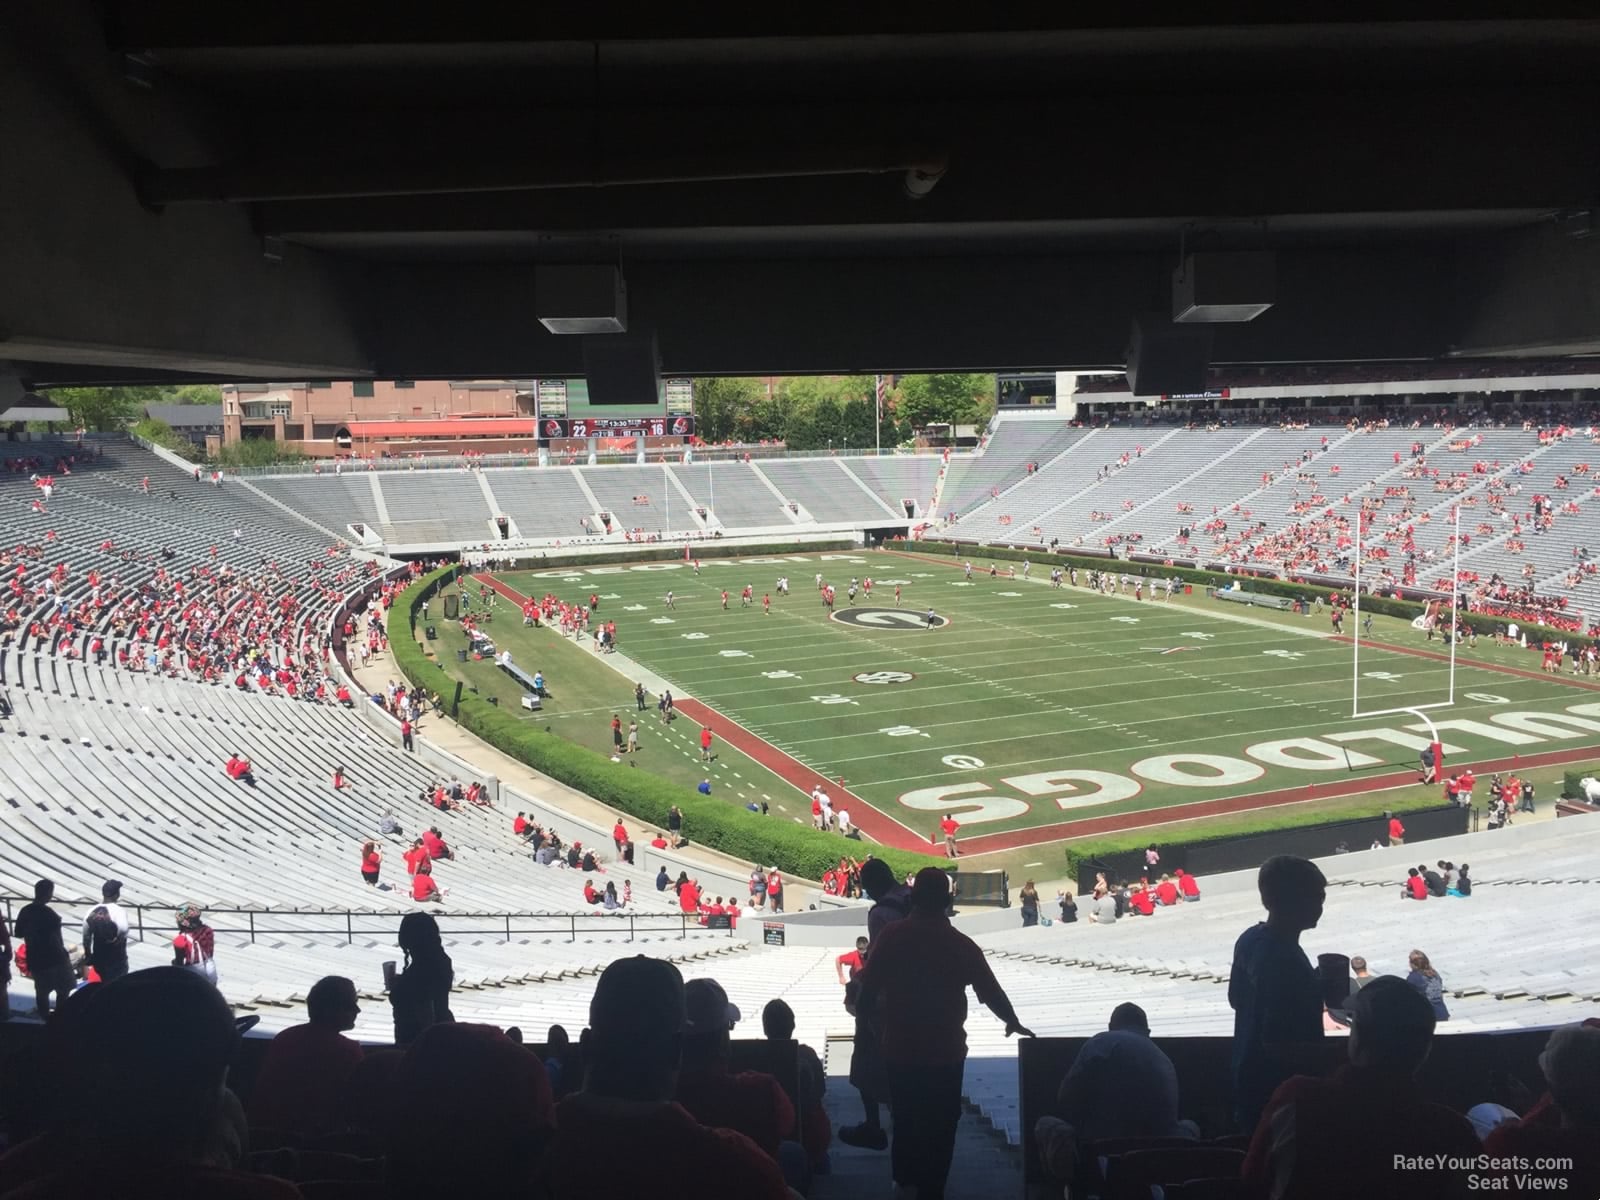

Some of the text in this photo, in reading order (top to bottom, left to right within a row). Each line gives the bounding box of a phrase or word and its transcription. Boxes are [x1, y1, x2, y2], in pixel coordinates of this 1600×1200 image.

[573, 425, 587, 437] 22
[651, 424, 664, 436] 16
[810, 694, 852, 705] 20
[878, 725, 921, 737] 10
[897, 702, 1600, 826] ULLDOGS
[941, 754, 985, 769] G
